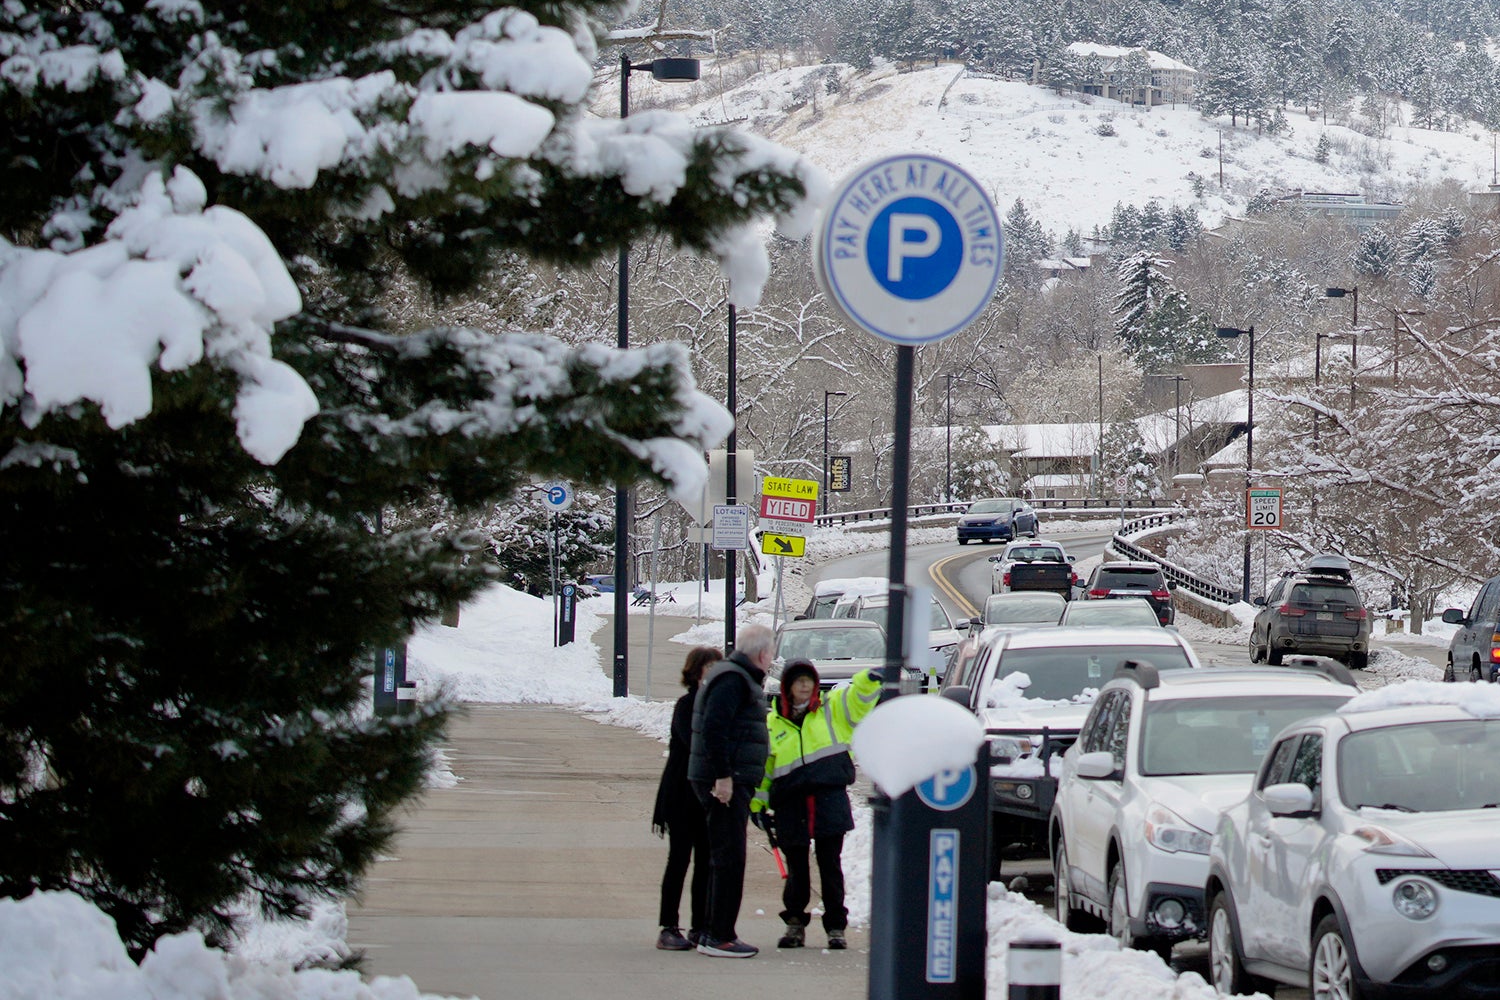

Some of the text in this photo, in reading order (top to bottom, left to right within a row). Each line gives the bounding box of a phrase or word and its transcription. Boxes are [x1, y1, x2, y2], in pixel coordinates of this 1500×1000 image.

[834, 162, 996, 268] PAY HERE AT ALL TIMES
[887, 212, 943, 282] P
[832, 459, 843, 489] Buffs
[551, 489, 563, 502] P
[767, 482, 814, 494] STATE LAW
[769, 500, 808, 517] YIELD
[1254, 512, 1276, 525] 20
[775, 520, 806, 528] PEDESTRIANS
[934, 835, 954, 894] PAY
[932, 901, 952, 976] HERE
